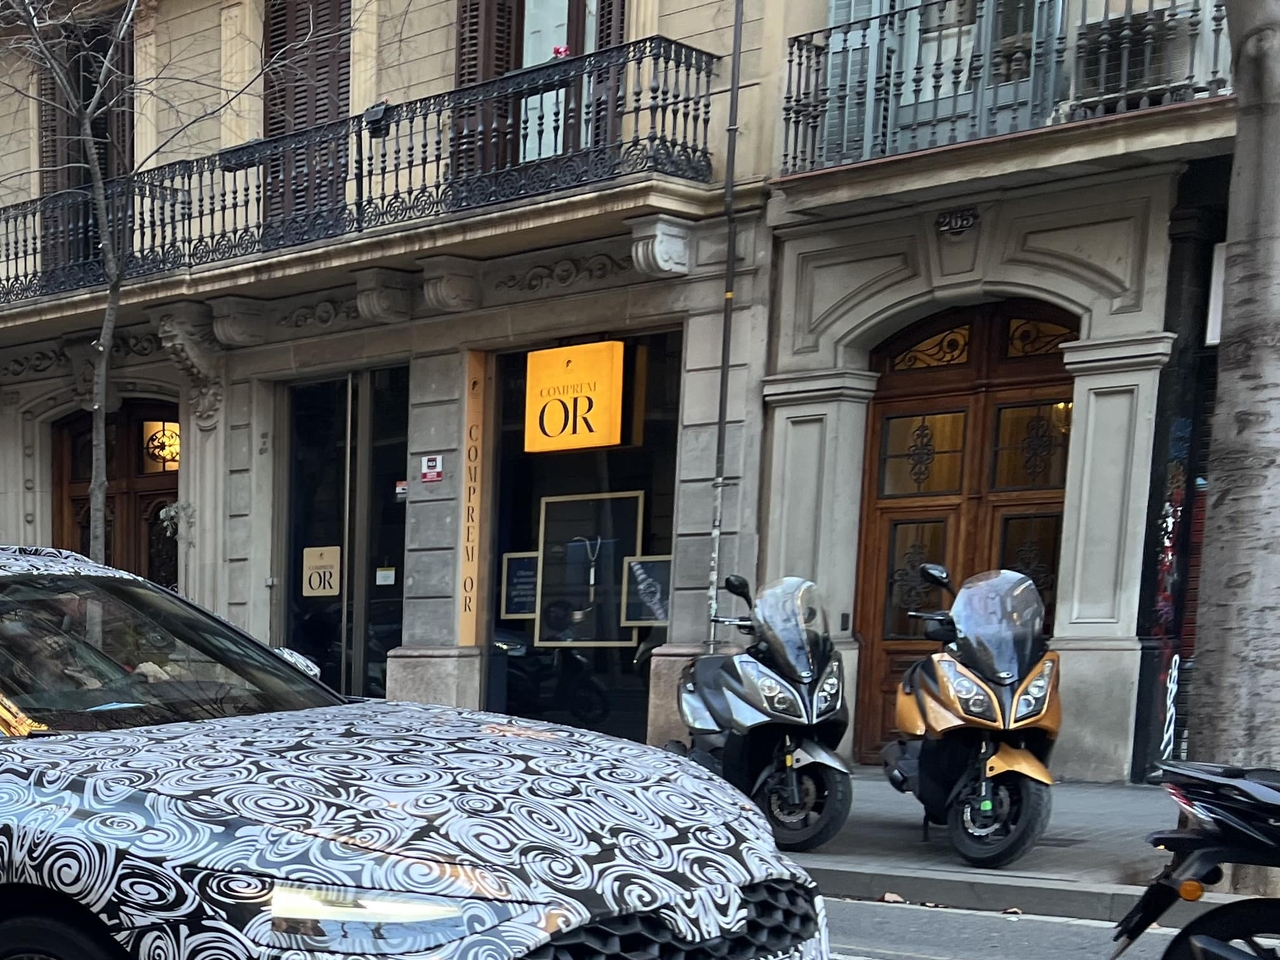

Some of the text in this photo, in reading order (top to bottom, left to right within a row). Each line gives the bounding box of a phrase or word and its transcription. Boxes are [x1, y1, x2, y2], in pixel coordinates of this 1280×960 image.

[939, 210, 974, 231] 265
[540, 381, 597, 397] COMPREM
[538, 395, 597, 438] OR
[463, 424, 480, 612] COMPREM OR
[308, 570, 334, 590] OR
